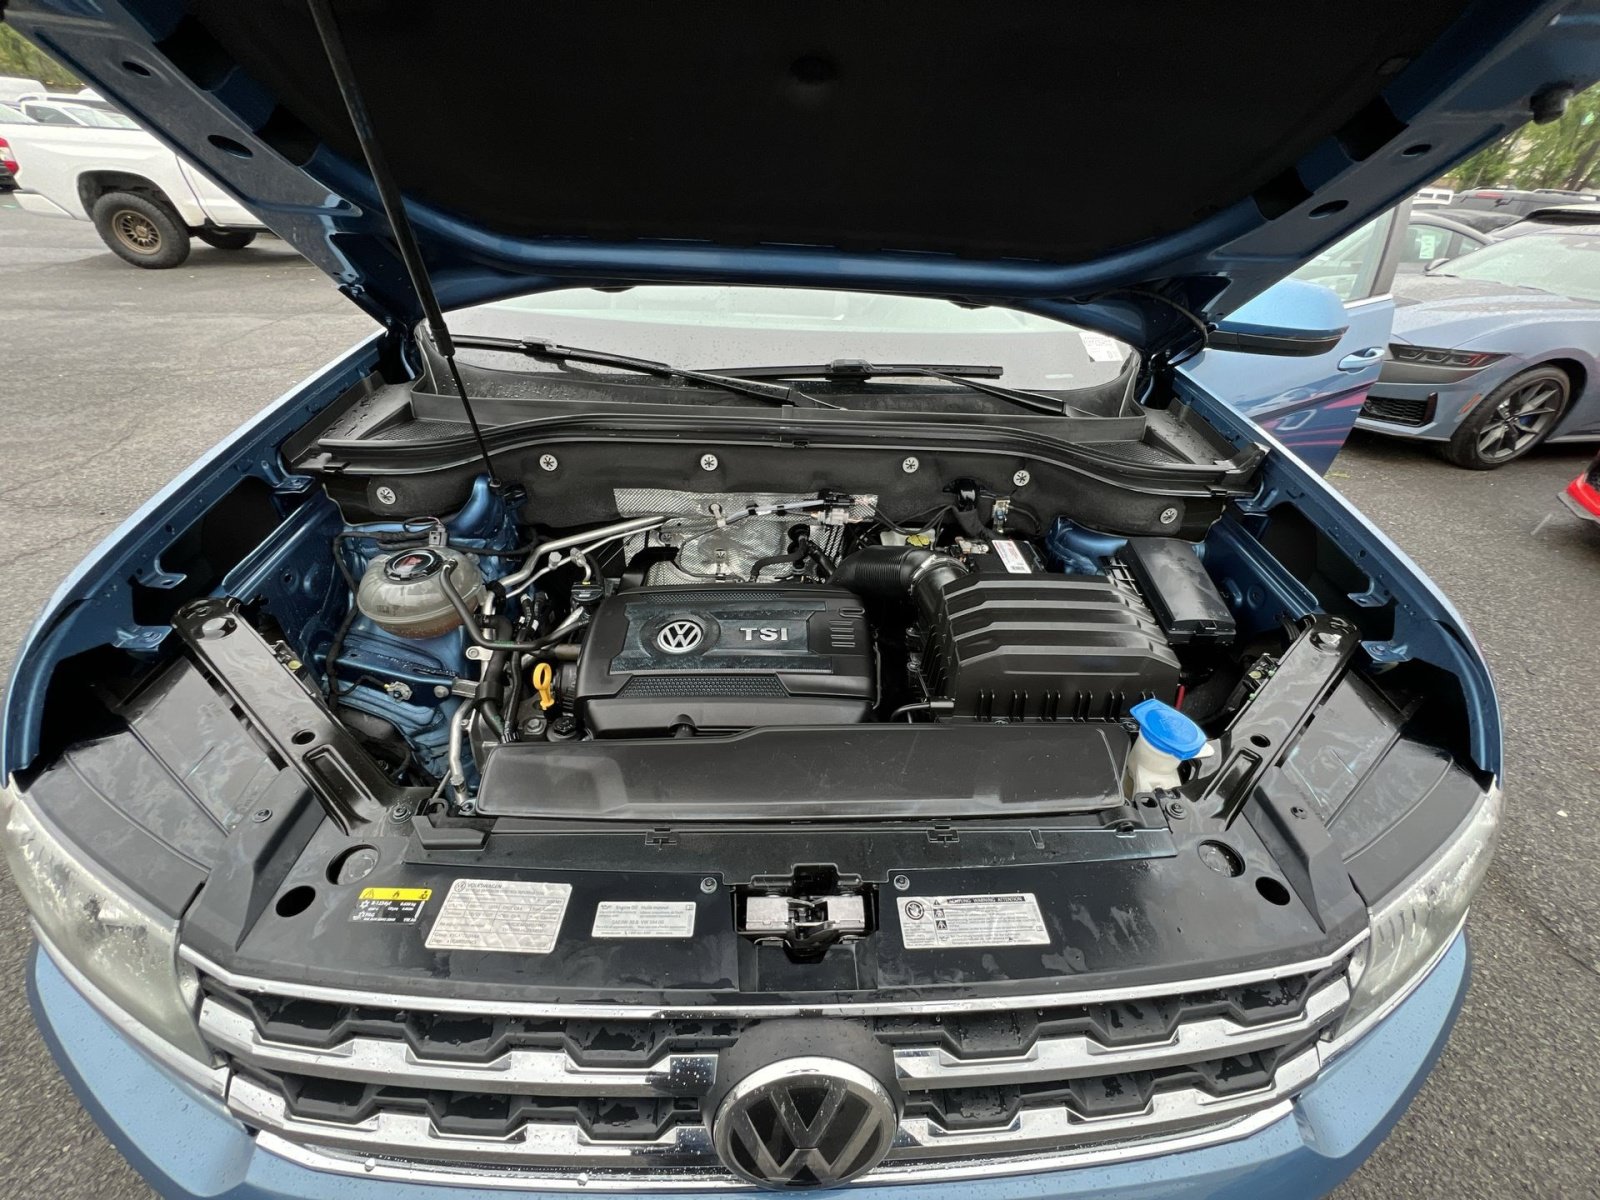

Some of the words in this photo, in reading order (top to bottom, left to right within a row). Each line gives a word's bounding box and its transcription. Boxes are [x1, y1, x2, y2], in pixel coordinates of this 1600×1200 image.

[658, 619, 703, 653] VW
[739, 627, 789, 641] TSI
[718, 1066, 893, 1190] VW
